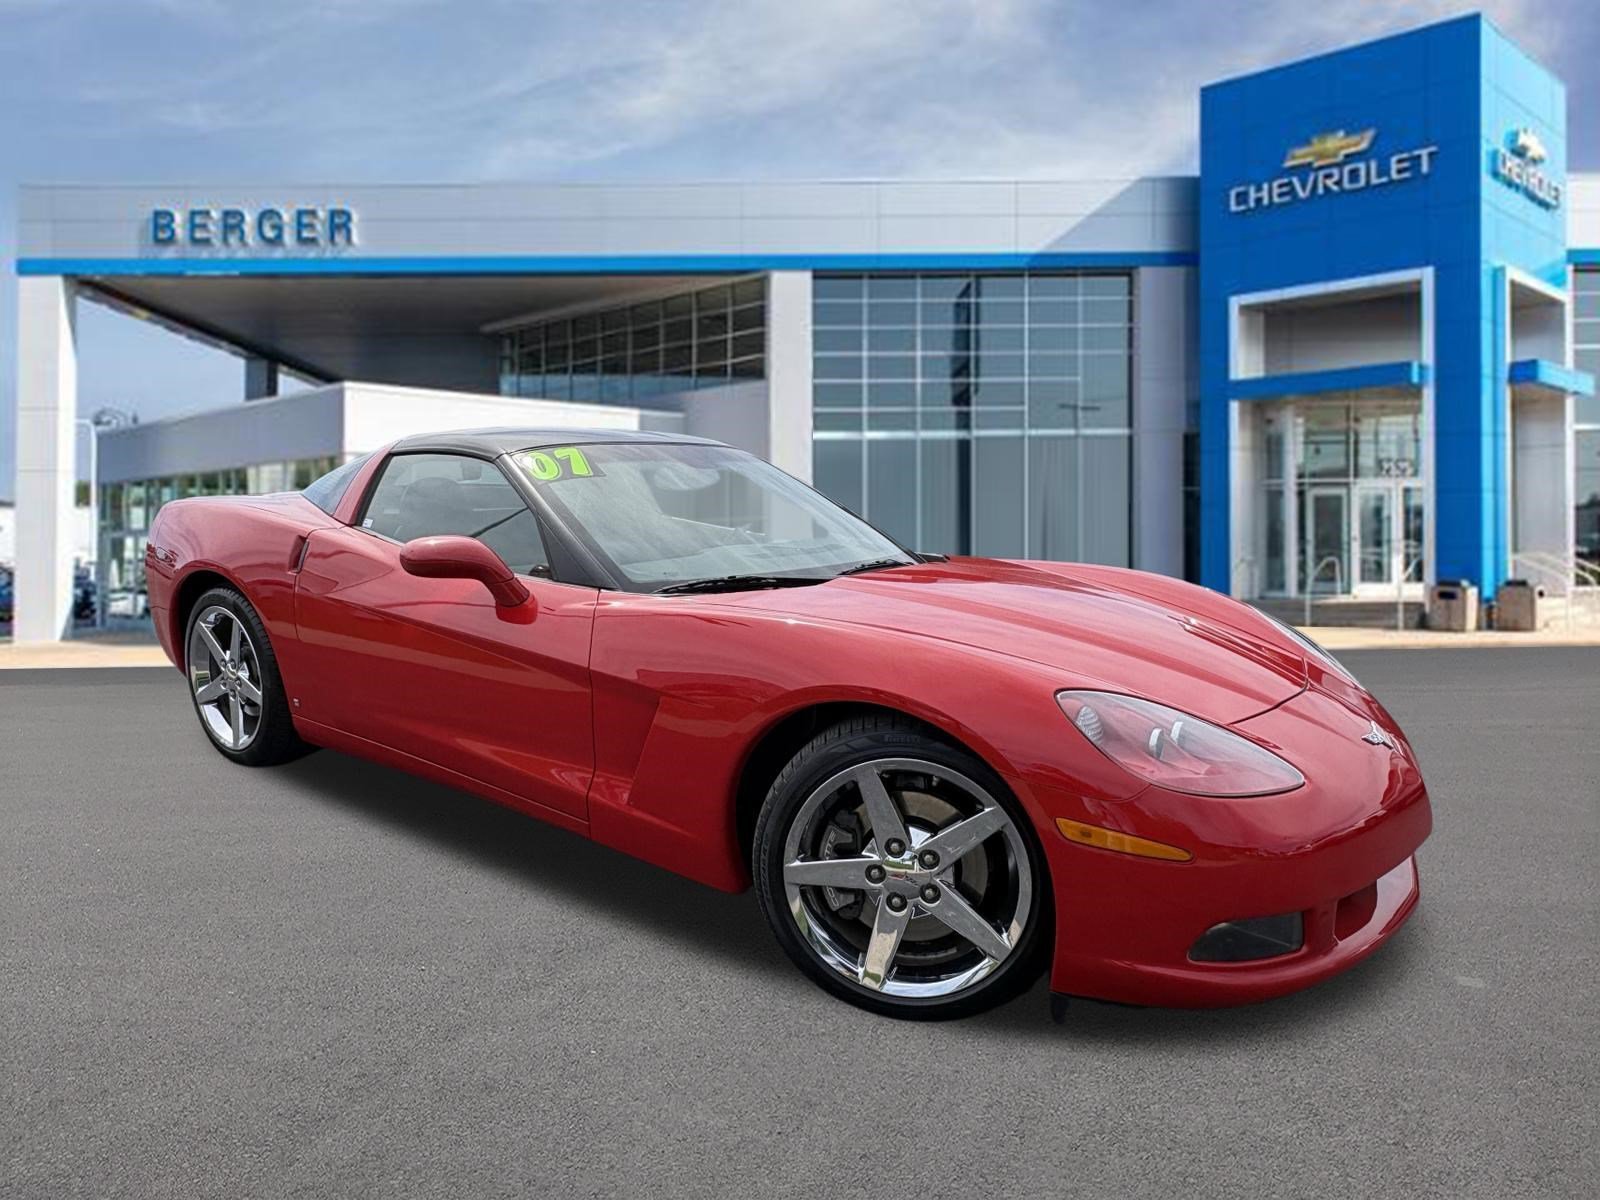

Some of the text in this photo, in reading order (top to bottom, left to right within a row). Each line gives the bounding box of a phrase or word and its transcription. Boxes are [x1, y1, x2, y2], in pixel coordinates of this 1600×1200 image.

[1229, 146, 1438, 213] CHEVROLET
[152, 209, 356, 245] BERGER
[525, 447, 593, 480] 07
